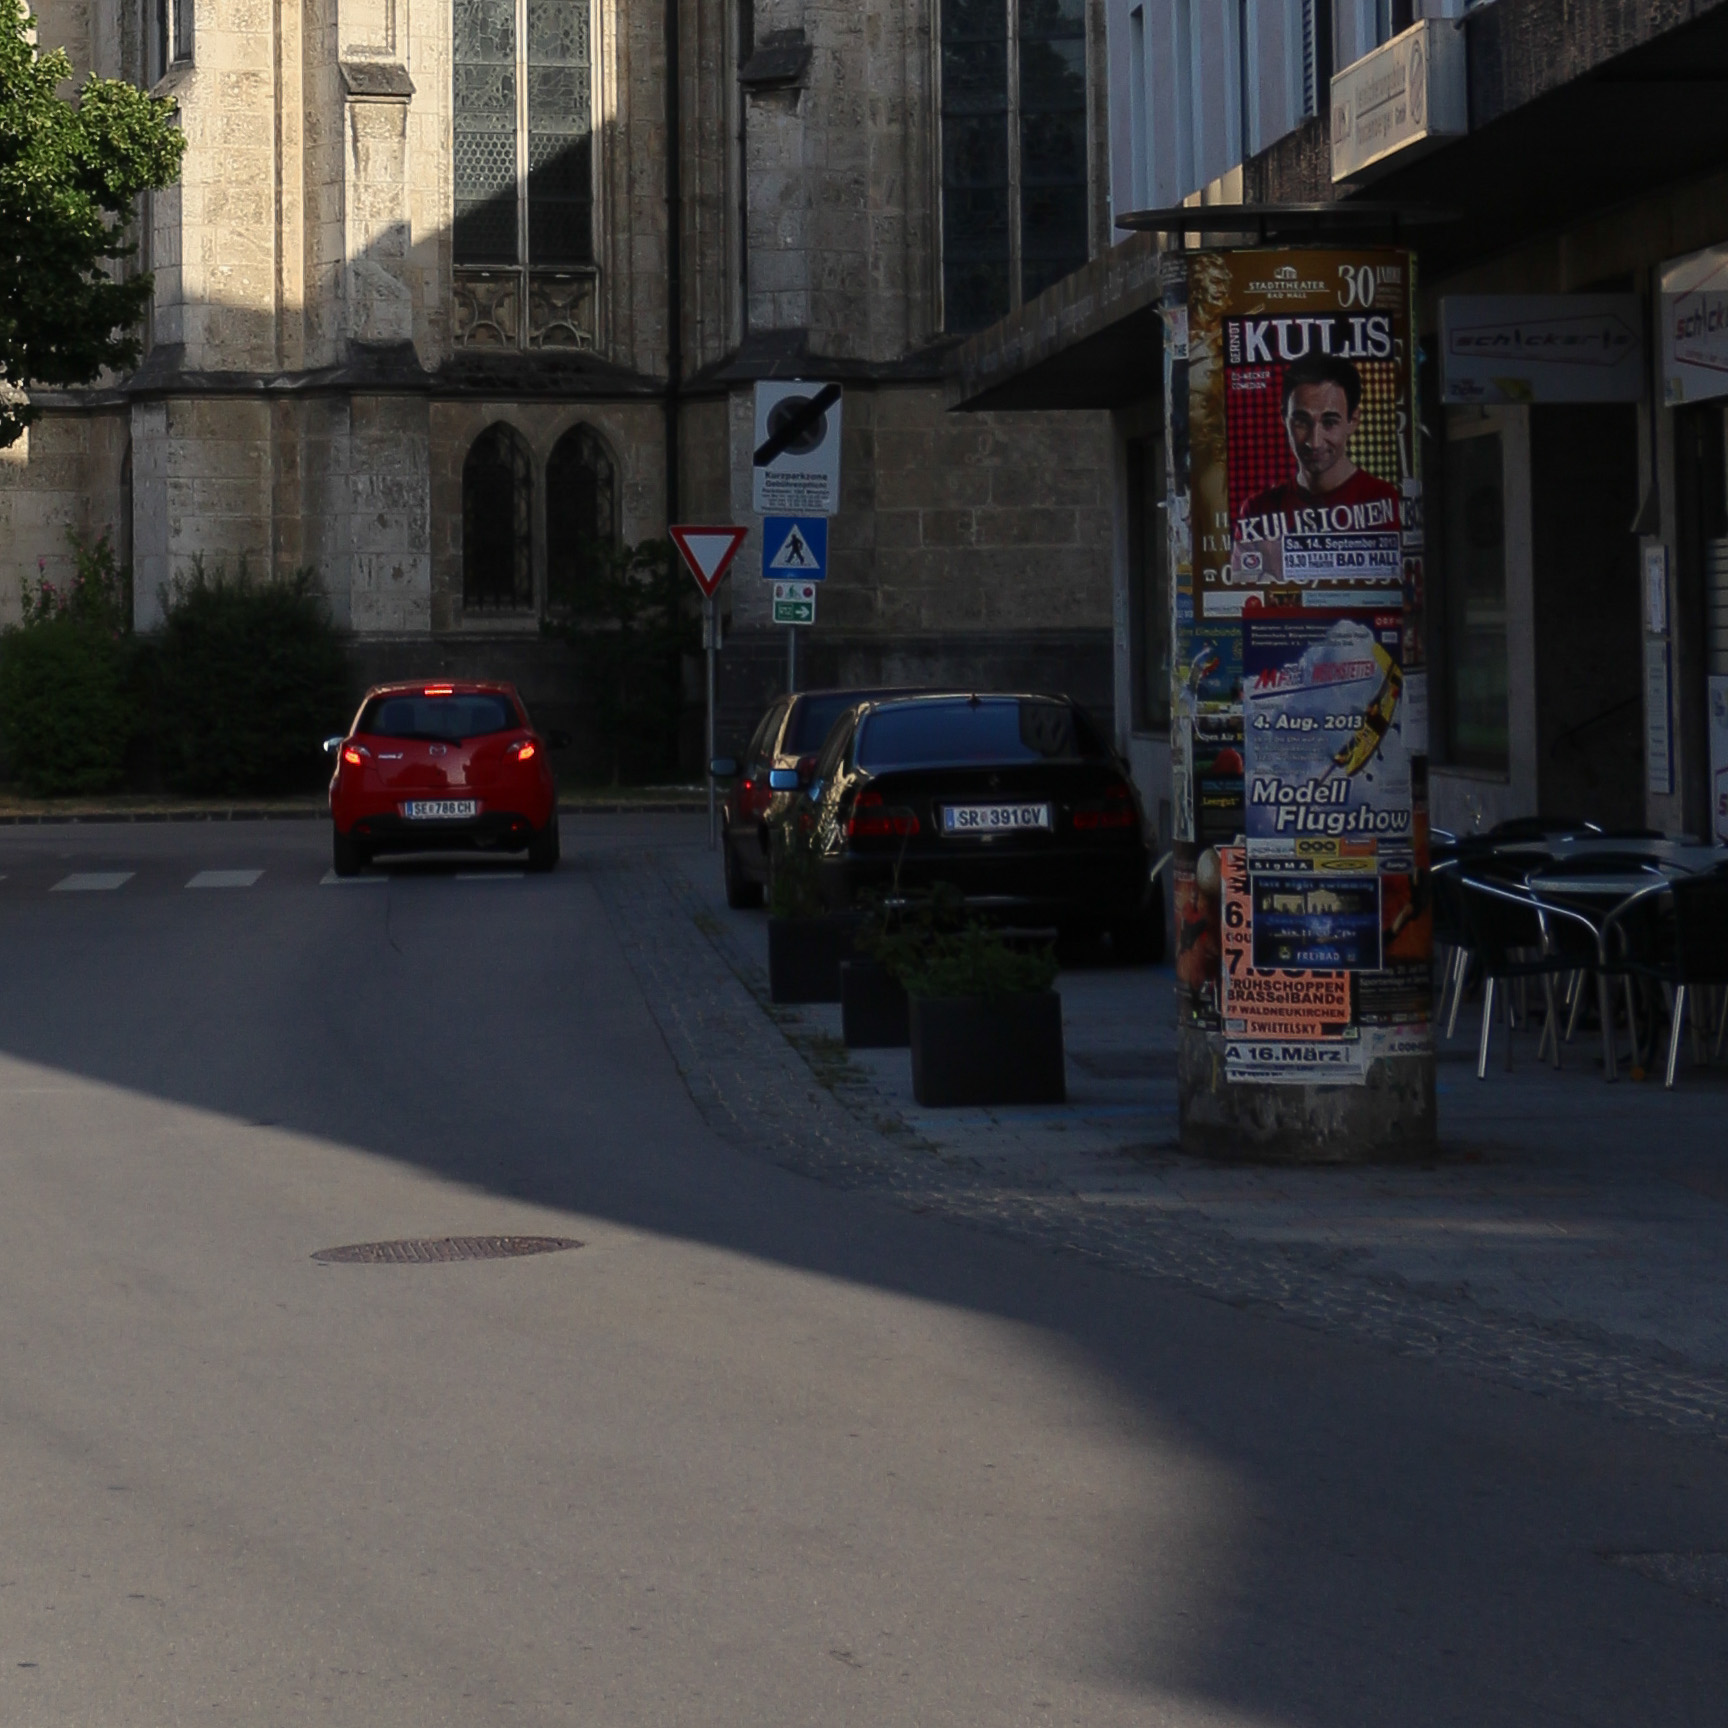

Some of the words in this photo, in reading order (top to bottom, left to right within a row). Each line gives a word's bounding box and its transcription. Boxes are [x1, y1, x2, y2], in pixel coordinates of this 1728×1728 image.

[1248, 280, 1326, 291] STADTTHEATER
[1337, 265, 1374, 308] 30
[1229, 321, 1241, 364] GERNOT
[1244, 316, 1391, 363] KULIS
[765, 472, 828, 481] Kurzparkzone
[1237, 497, 1395, 544] KULISIONEN
[1285, 538, 1303, 551] Sa.
[1305, 537, 1322, 550] 14.
[1325, 536, 1376, 551] September
[1336, 553, 1365, 567] BAD
[1368, 552, 1399, 566] HALL
[1253, 714, 1270, 730] 4.
[1275, 713, 1319, 731] Aug.
[1324, 713, 1363, 730] 2013
[1252, 779, 1349, 804] Modell
[414, 803, 427, 815] SE
[457, 802, 471, 813] CH
[959, 810, 979, 826] SR
[1276, 805, 1410, 834] Flugshow
[1225, 901, 1251, 928] 6.
[1296, 951, 1340, 961] FREIBAD
[1240, 1006, 1346, 1018] WALDNEUKIRCHEN
[1251, 1021, 1317, 1034] SWIETELSKY
